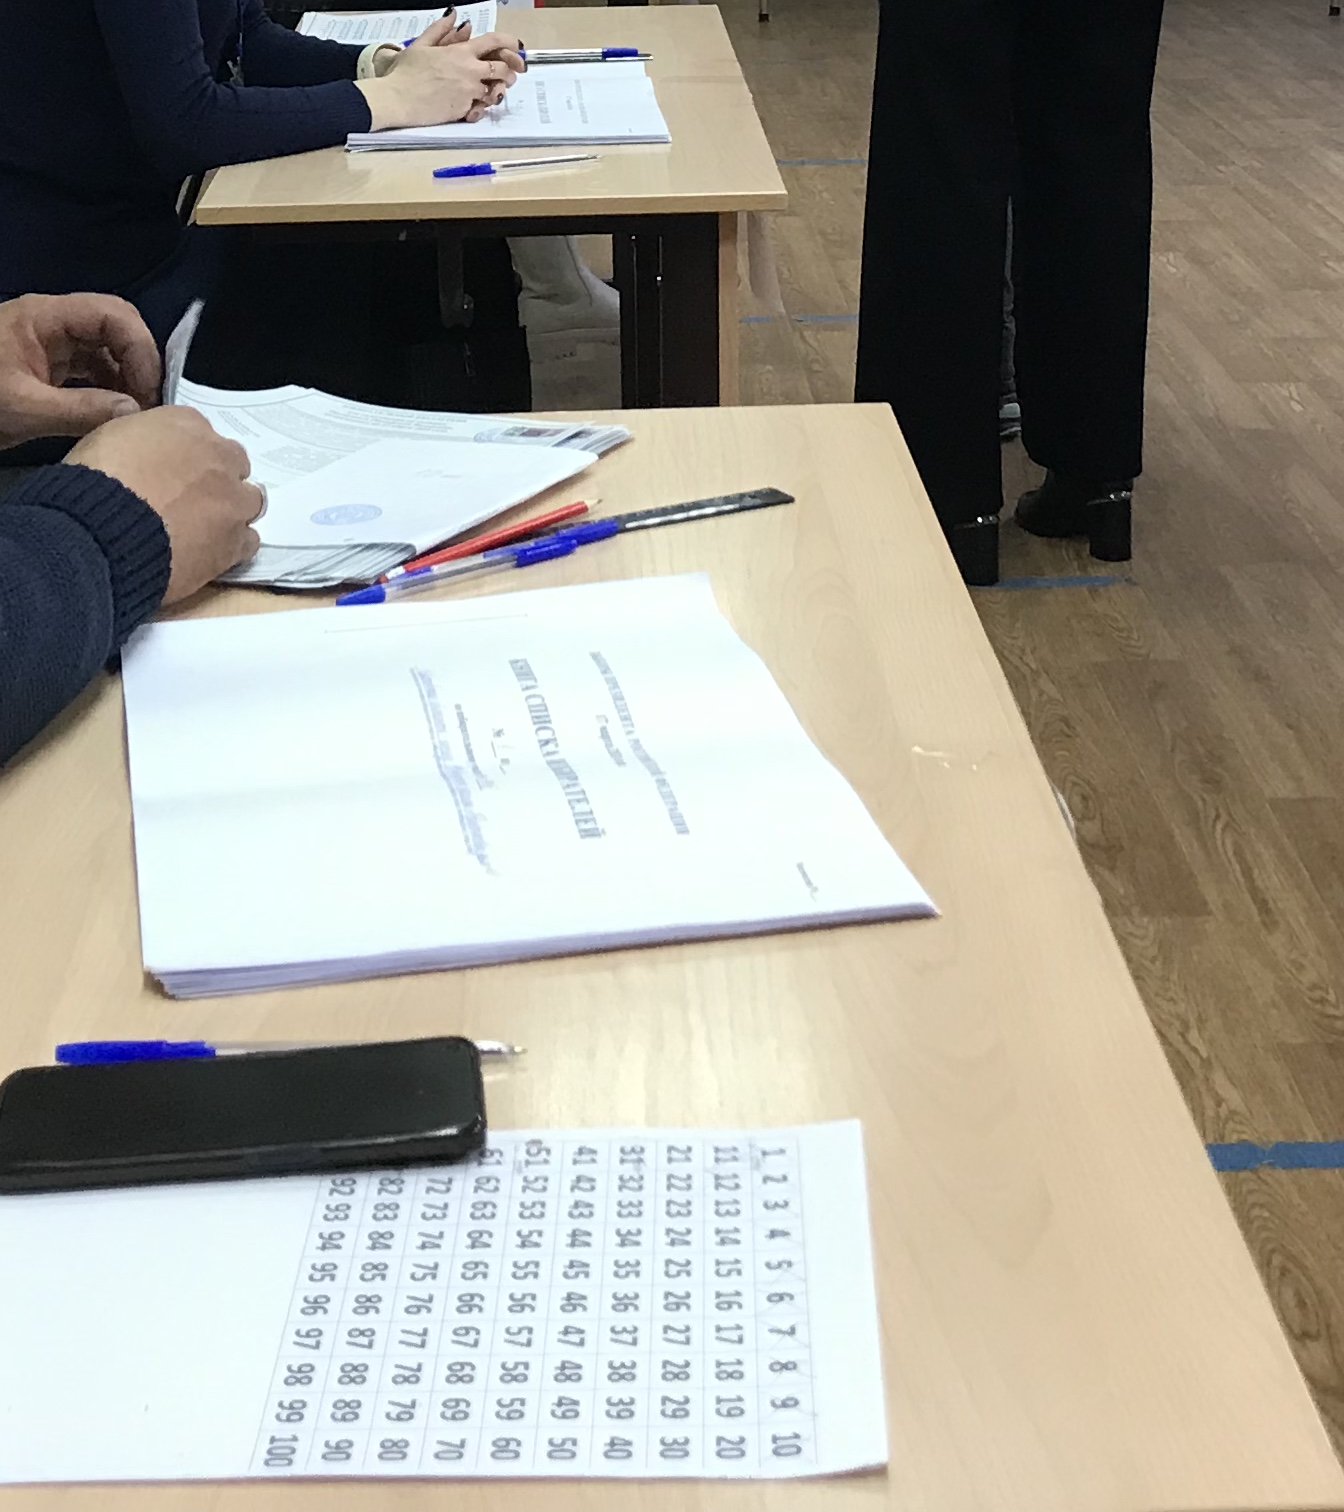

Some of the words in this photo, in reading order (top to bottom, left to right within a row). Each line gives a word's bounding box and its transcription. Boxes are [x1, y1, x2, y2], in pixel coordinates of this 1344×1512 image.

[524, 693, 560, 759] СПИСКА
[572, 1146, 598, 1166] 41
[619, 1146, 645, 1165] 31
[666, 1145, 693, 1164] 21
[713, 1146, 739, 1164] 11
[761, 1148, 786, 1158] 1
[328, 1178, 357, 1196] 92
[377, 1177, 405, 1196] 82
[425, 1177, 453, 1194] 72
[473, 1176, 501, 1194] 62
[521, 1175, 549, 1194] 52
[570, 1174, 596, 1193] 42
[617, 1174, 644, 1192] 32
[666, 1173, 693, 1192] 22
[713, 1173, 741, 1191] 12
[762, 1174, 788, 1184] 2
[322, 1203, 352, 1222] 93
[371, 1202, 401, 1222] 83
[420, 1202, 449, 1222] 73
[469, 1200, 498, 1221] 63
[518, 1200, 547, 1220] 53
[567, 1199, 594, 1220] 43
[616, 1200, 643, 1219] 33
[665, 1199, 692, 1218] 23
[714, 1199, 741, 1218] 13
[762, 1200, 789, 1211] 3
[316, 1230, 346, 1252] 94
[366, 1230, 395, 1251] 84
[416, 1230, 445, 1251] 74
[466, 1229, 494, 1250] 64
[516, 1229, 544, 1250] 54
[566, 1228, 593, 1249] 44
[615, 1228, 643, 1248] 34
[665, 1227, 692, 1247] 24
[714, 1227, 741, 1247] 14
[765, 1228, 791, 1240] 4
[308, 1262, 339, 1283] 95
[359, 1261, 389, 1283] 85
[409, 1261, 440, 1282] 75
[460, 1260, 490, 1281] 65
[511, 1260, 540, 1281] 55
[562, 1259, 591, 1280] 45
[613, 1259, 641, 1279] 35
[663, 1258, 692, 1279] 25
[714, 1258, 743, 1278] 15
[764, 1260, 793, 1270] 5
[300, 1294, 331, 1316] 96
[352, 1294, 383, 1316] 86
[404, 1293, 434, 1315] 76
[455, 1292, 485, 1315] 66
[507, 1292, 537, 1314] 56
[559, 1291, 588, 1313] 46
[611, 1292, 640, 1313] 36
[663, 1291, 692, 1312] 26
[715, 1290, 743, 1311] 16
[766, 1292, 795, 1304] 6
[293, 1327, 324, 1350] 97
[346, 1327, 376, 1350] 87
[398, 1327, 429, 1349] 77
[451, 1326, 481, 1349] 67
[504, 1326, 534, 1348] 57
[557, 1325, 586, 1348] 47
[609, 1325, 639, 1347] 37
[662, 1324, 691, 1346] 27
[715, 1323, 744, 1345] 17
[768, 1324, 797, 1337] 7
[283, 1362, 316, 1387] 98
[337, 1362, 369, 1386] 88
[391, 1362, 423, 1386] 78
[445, 1361, 476, 1385] 68
[499, 1361, 530, 1384] 58
[553, 1360, 583, 1383] 48
[607, 1360, 637, 1383] 38
[661, 1359, 691, 1382] 28
[715, 1358, 745, 1381] 18
[768, 1360, 798, 1373] 8
[275, 1399, 308, 1424] 99
[330, 1398, 363, 1423] 89
[385, 1398, 417, 1423] 79
[439, 1397, 471, 1422] 69
[494, 1397, 526, 1421] 59
[550, 1396, 580, 1420] 49
[605, 1397, 636, 1420] 39
[660, 1395, 691, 1420] 29
[715, 1395, 746, 1418] 19
[770, 1396, 800, 1410] 9
[263, 1434, 299, 1467] 100
[321, 1438, 354, 1462] 90
[377, 1438, 410, 1461] 80
[433, 1438, 466, 1461] 70
[490, 1437, 522, 1461] 60
[546, 1437, 578, 1460] 50
[603, 1436, 633, 1460] 40
[659, 1436, 690, 1460] 30
[715, 1435, 746, 1460] 20
[771, 1432, 803, 1458] 10
